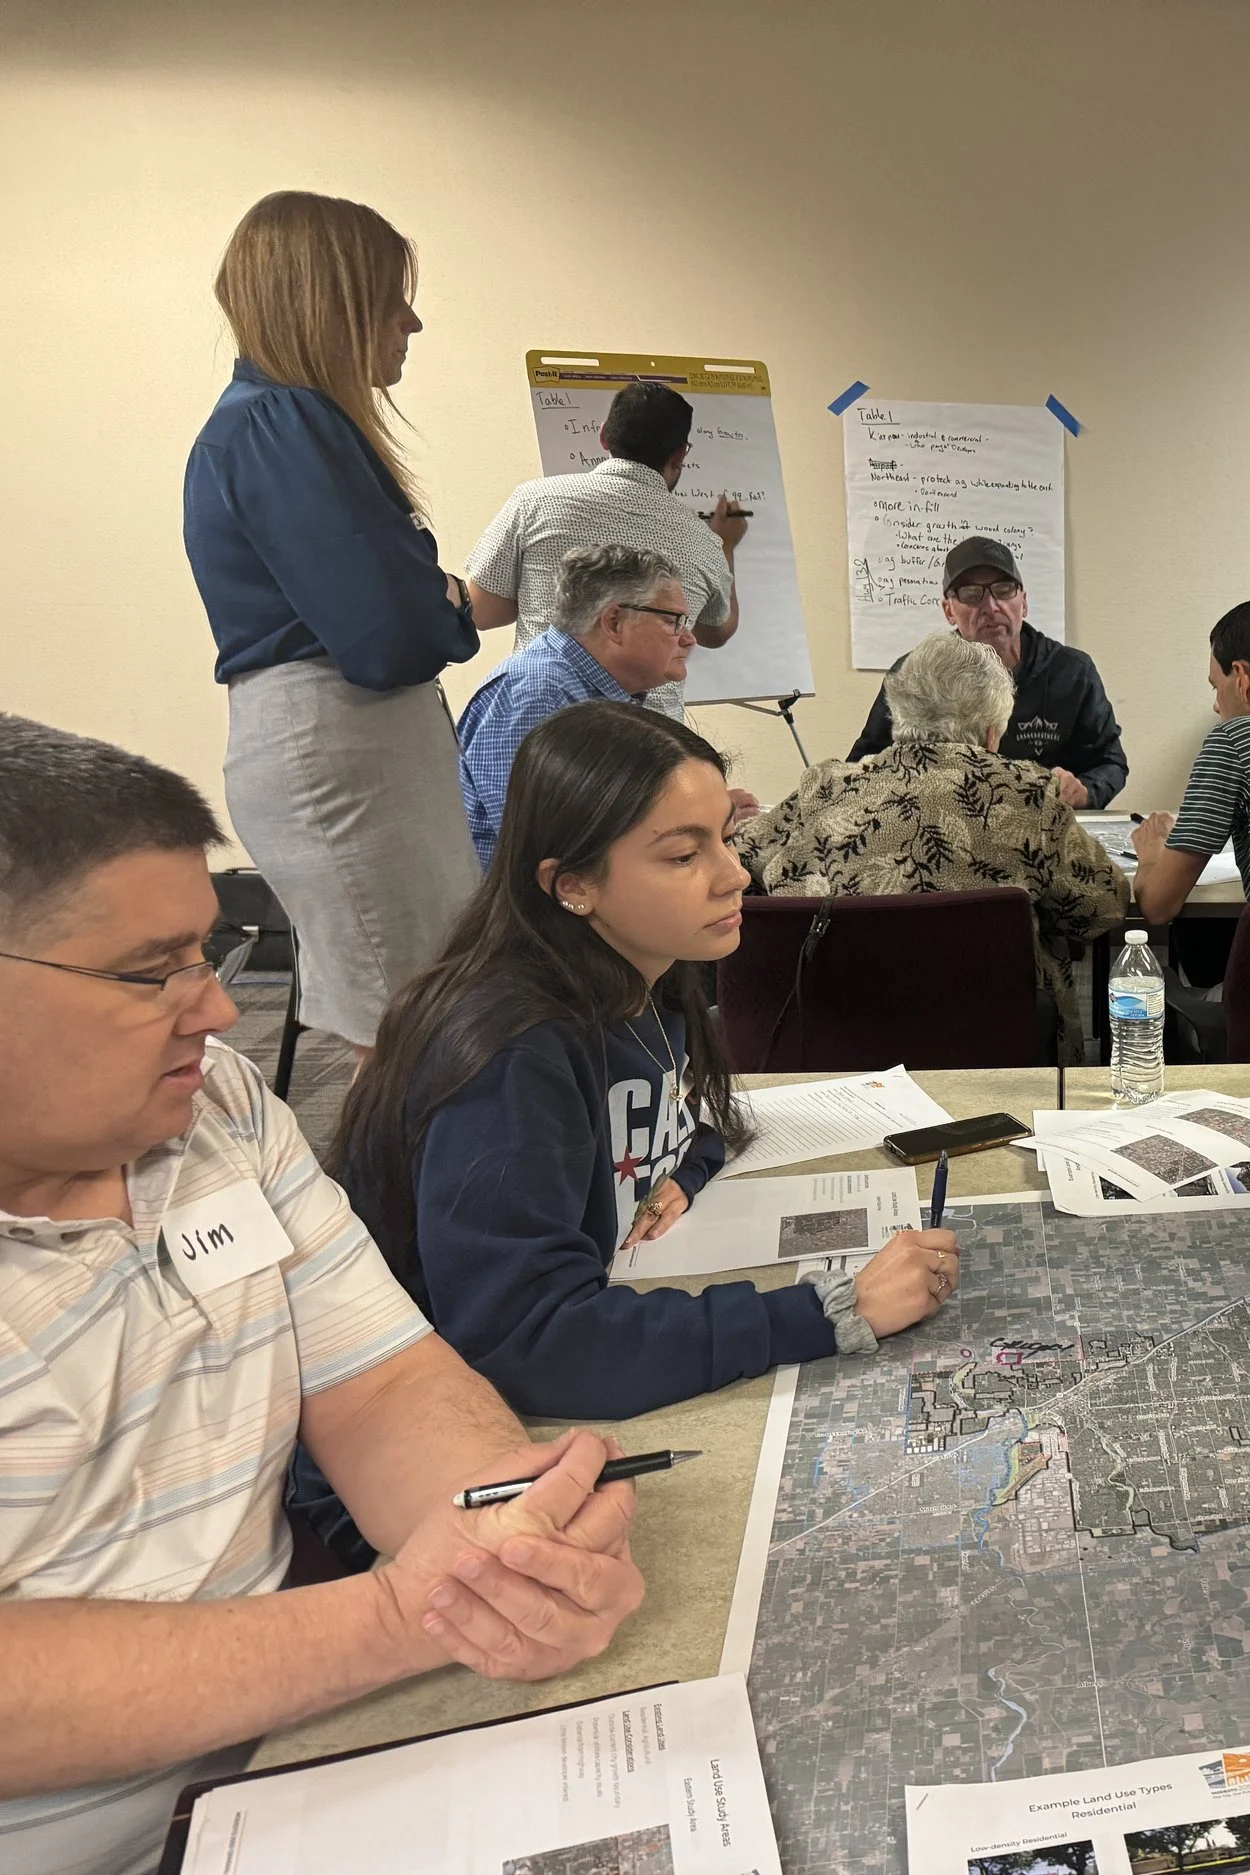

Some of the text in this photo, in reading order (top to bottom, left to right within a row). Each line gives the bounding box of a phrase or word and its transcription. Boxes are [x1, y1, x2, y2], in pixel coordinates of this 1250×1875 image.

[536, 391, 565, 406] Table
[857, 408, 893, 423] Table 1
[180, 1223, 234, 1261] Jim
[710, 1758, 732, 1848] Land Use Study Areas
[1029, 1782, 1173, 1813] Example Land Use Types
[1070, 1801, 1138, 1820] Residential
[969, 1831, 1068, 1854] Low-density Residential
